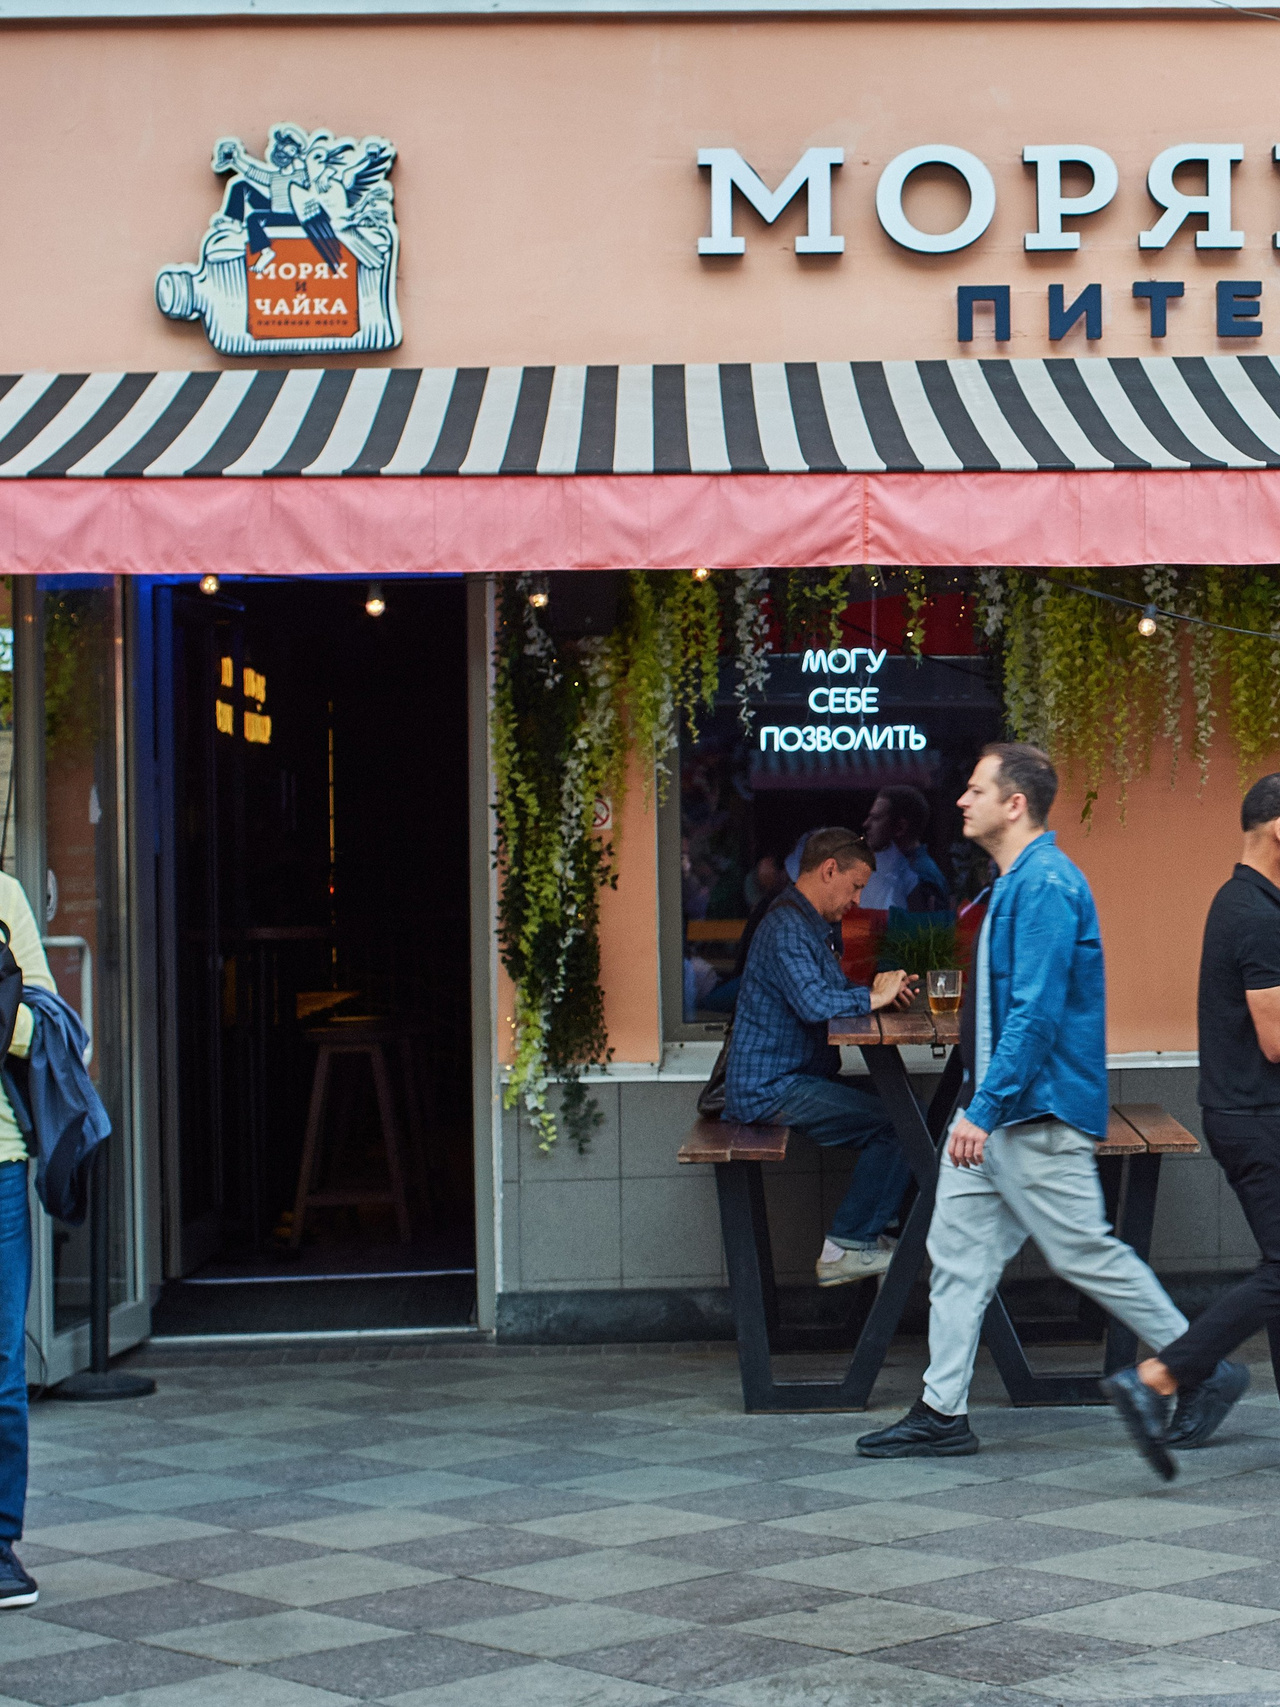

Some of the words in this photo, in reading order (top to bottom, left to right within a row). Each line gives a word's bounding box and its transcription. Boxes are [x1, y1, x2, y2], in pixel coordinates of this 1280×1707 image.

[254, 293, 348, 315] ЧАЙКА
[801, 647, 888, 675] МОГУ
[808, 686, 880, 714] СЕБЕ
[759, 724, 928, 753] ПОЗВОЛИТЬ
